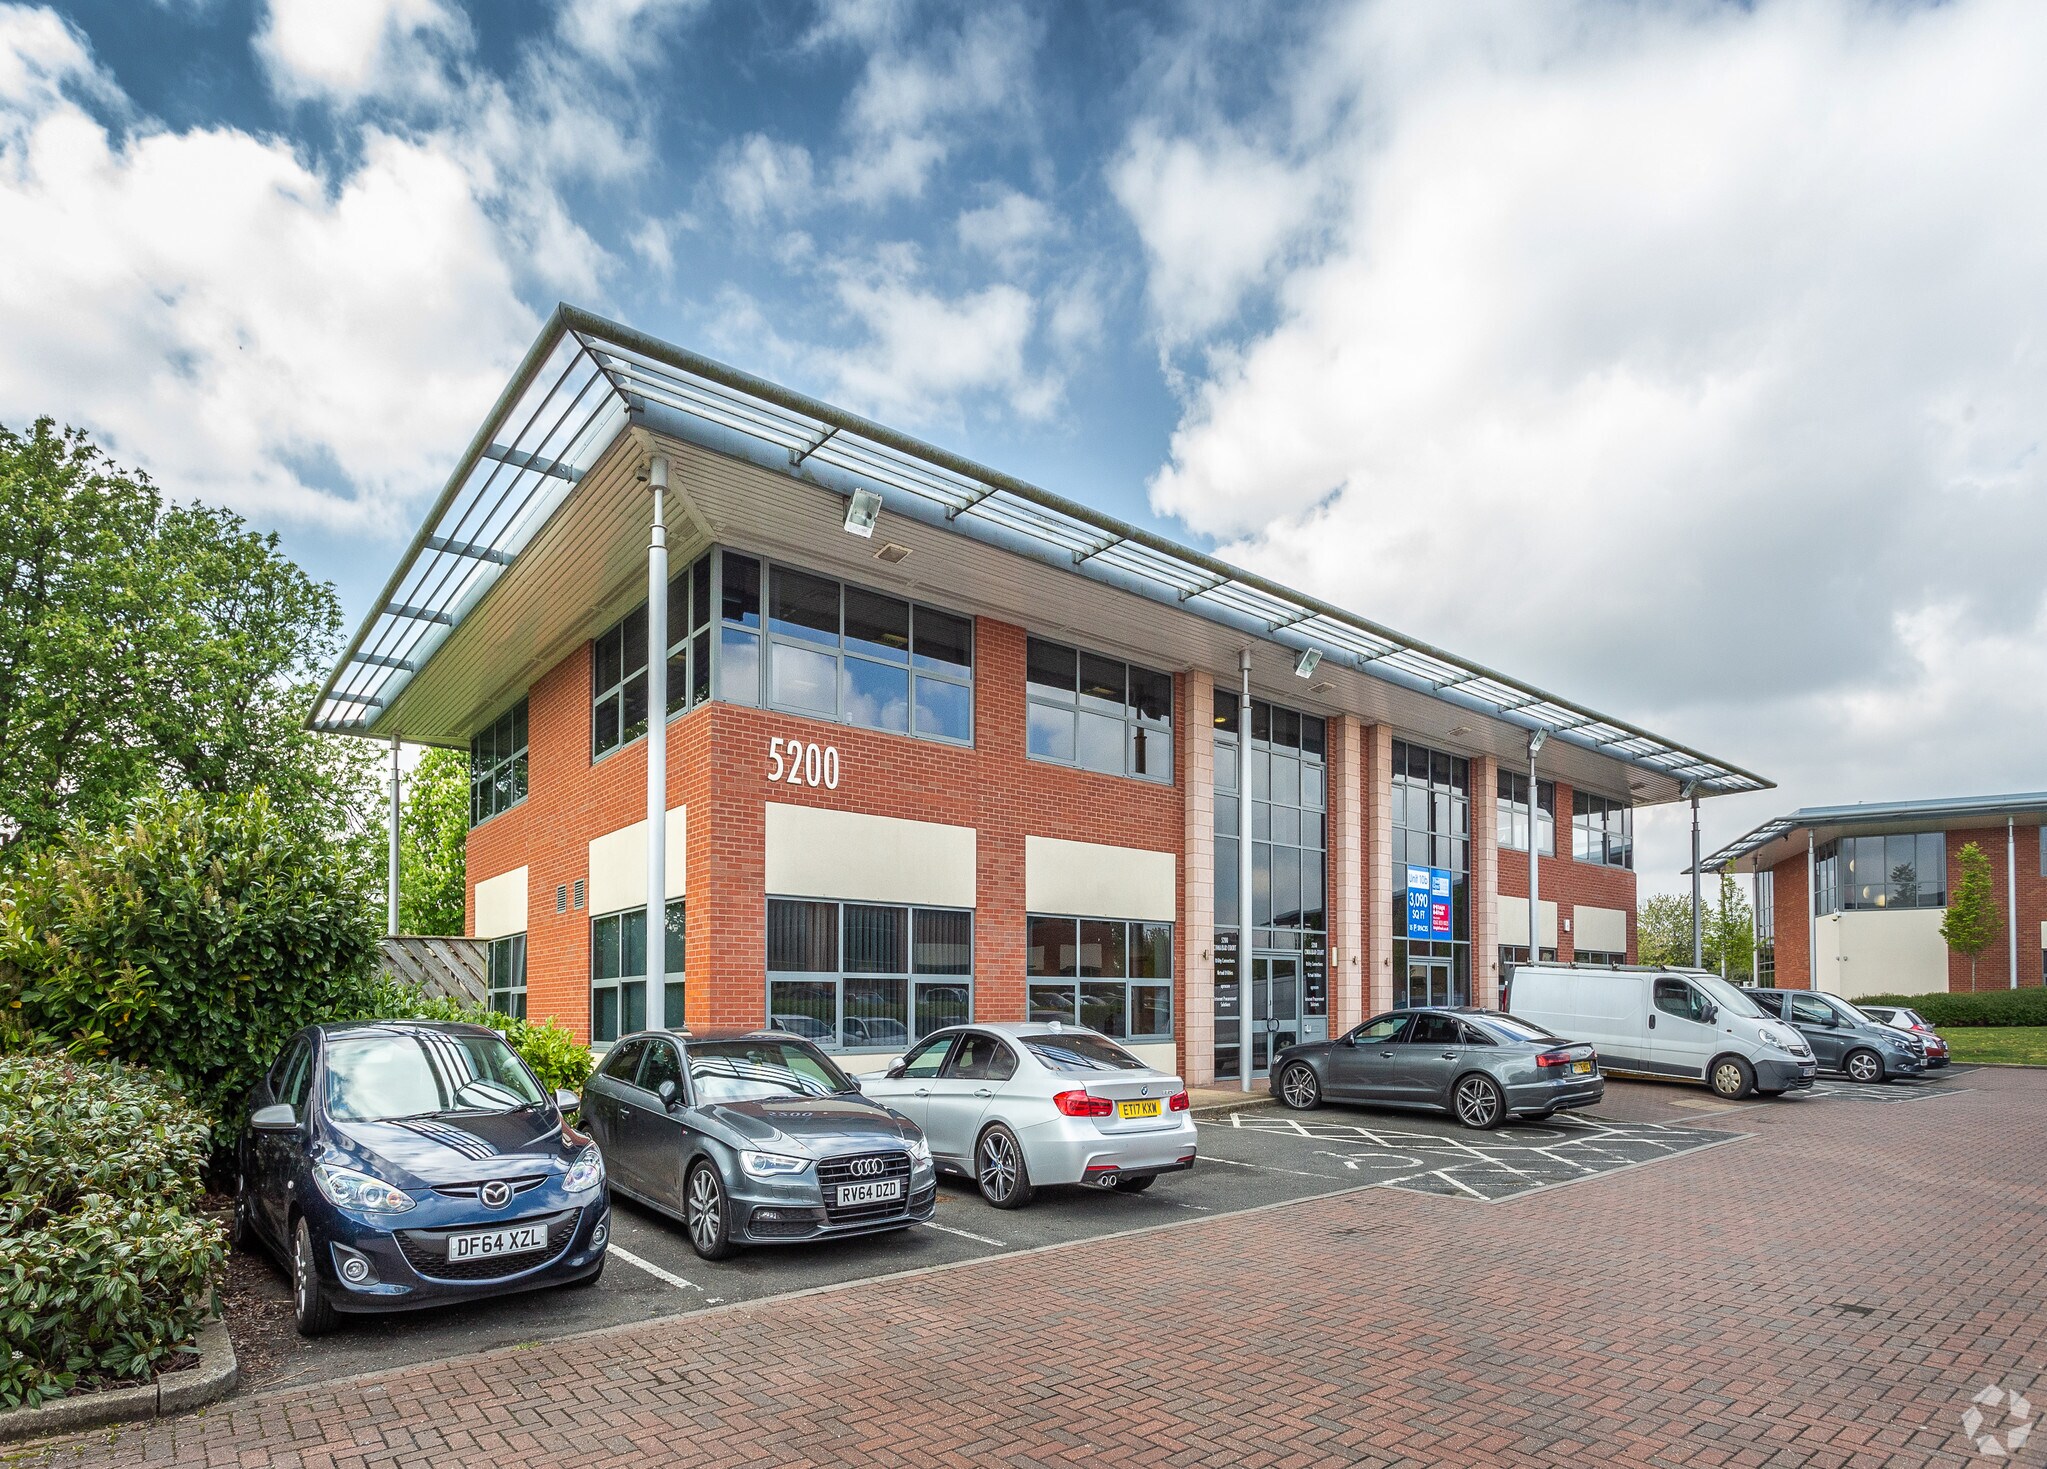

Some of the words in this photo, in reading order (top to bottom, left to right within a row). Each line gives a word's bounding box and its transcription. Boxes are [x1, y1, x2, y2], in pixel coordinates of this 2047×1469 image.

[767, 736, 839, 790] 5200
[1409, 892, 1428, 908] 3,090
[1412, 910, 1419, 919] SQ
[1420, 910, 1425, 919] FT
[1123, 1103, 1140, 1116] ET17
[842, 1184, 873, 1202] RV64
[875, 1182, 896, 1198] DZD
[457, 1233, 504, 1256] DF64
[509, 1229, 541, 1249] XZL
